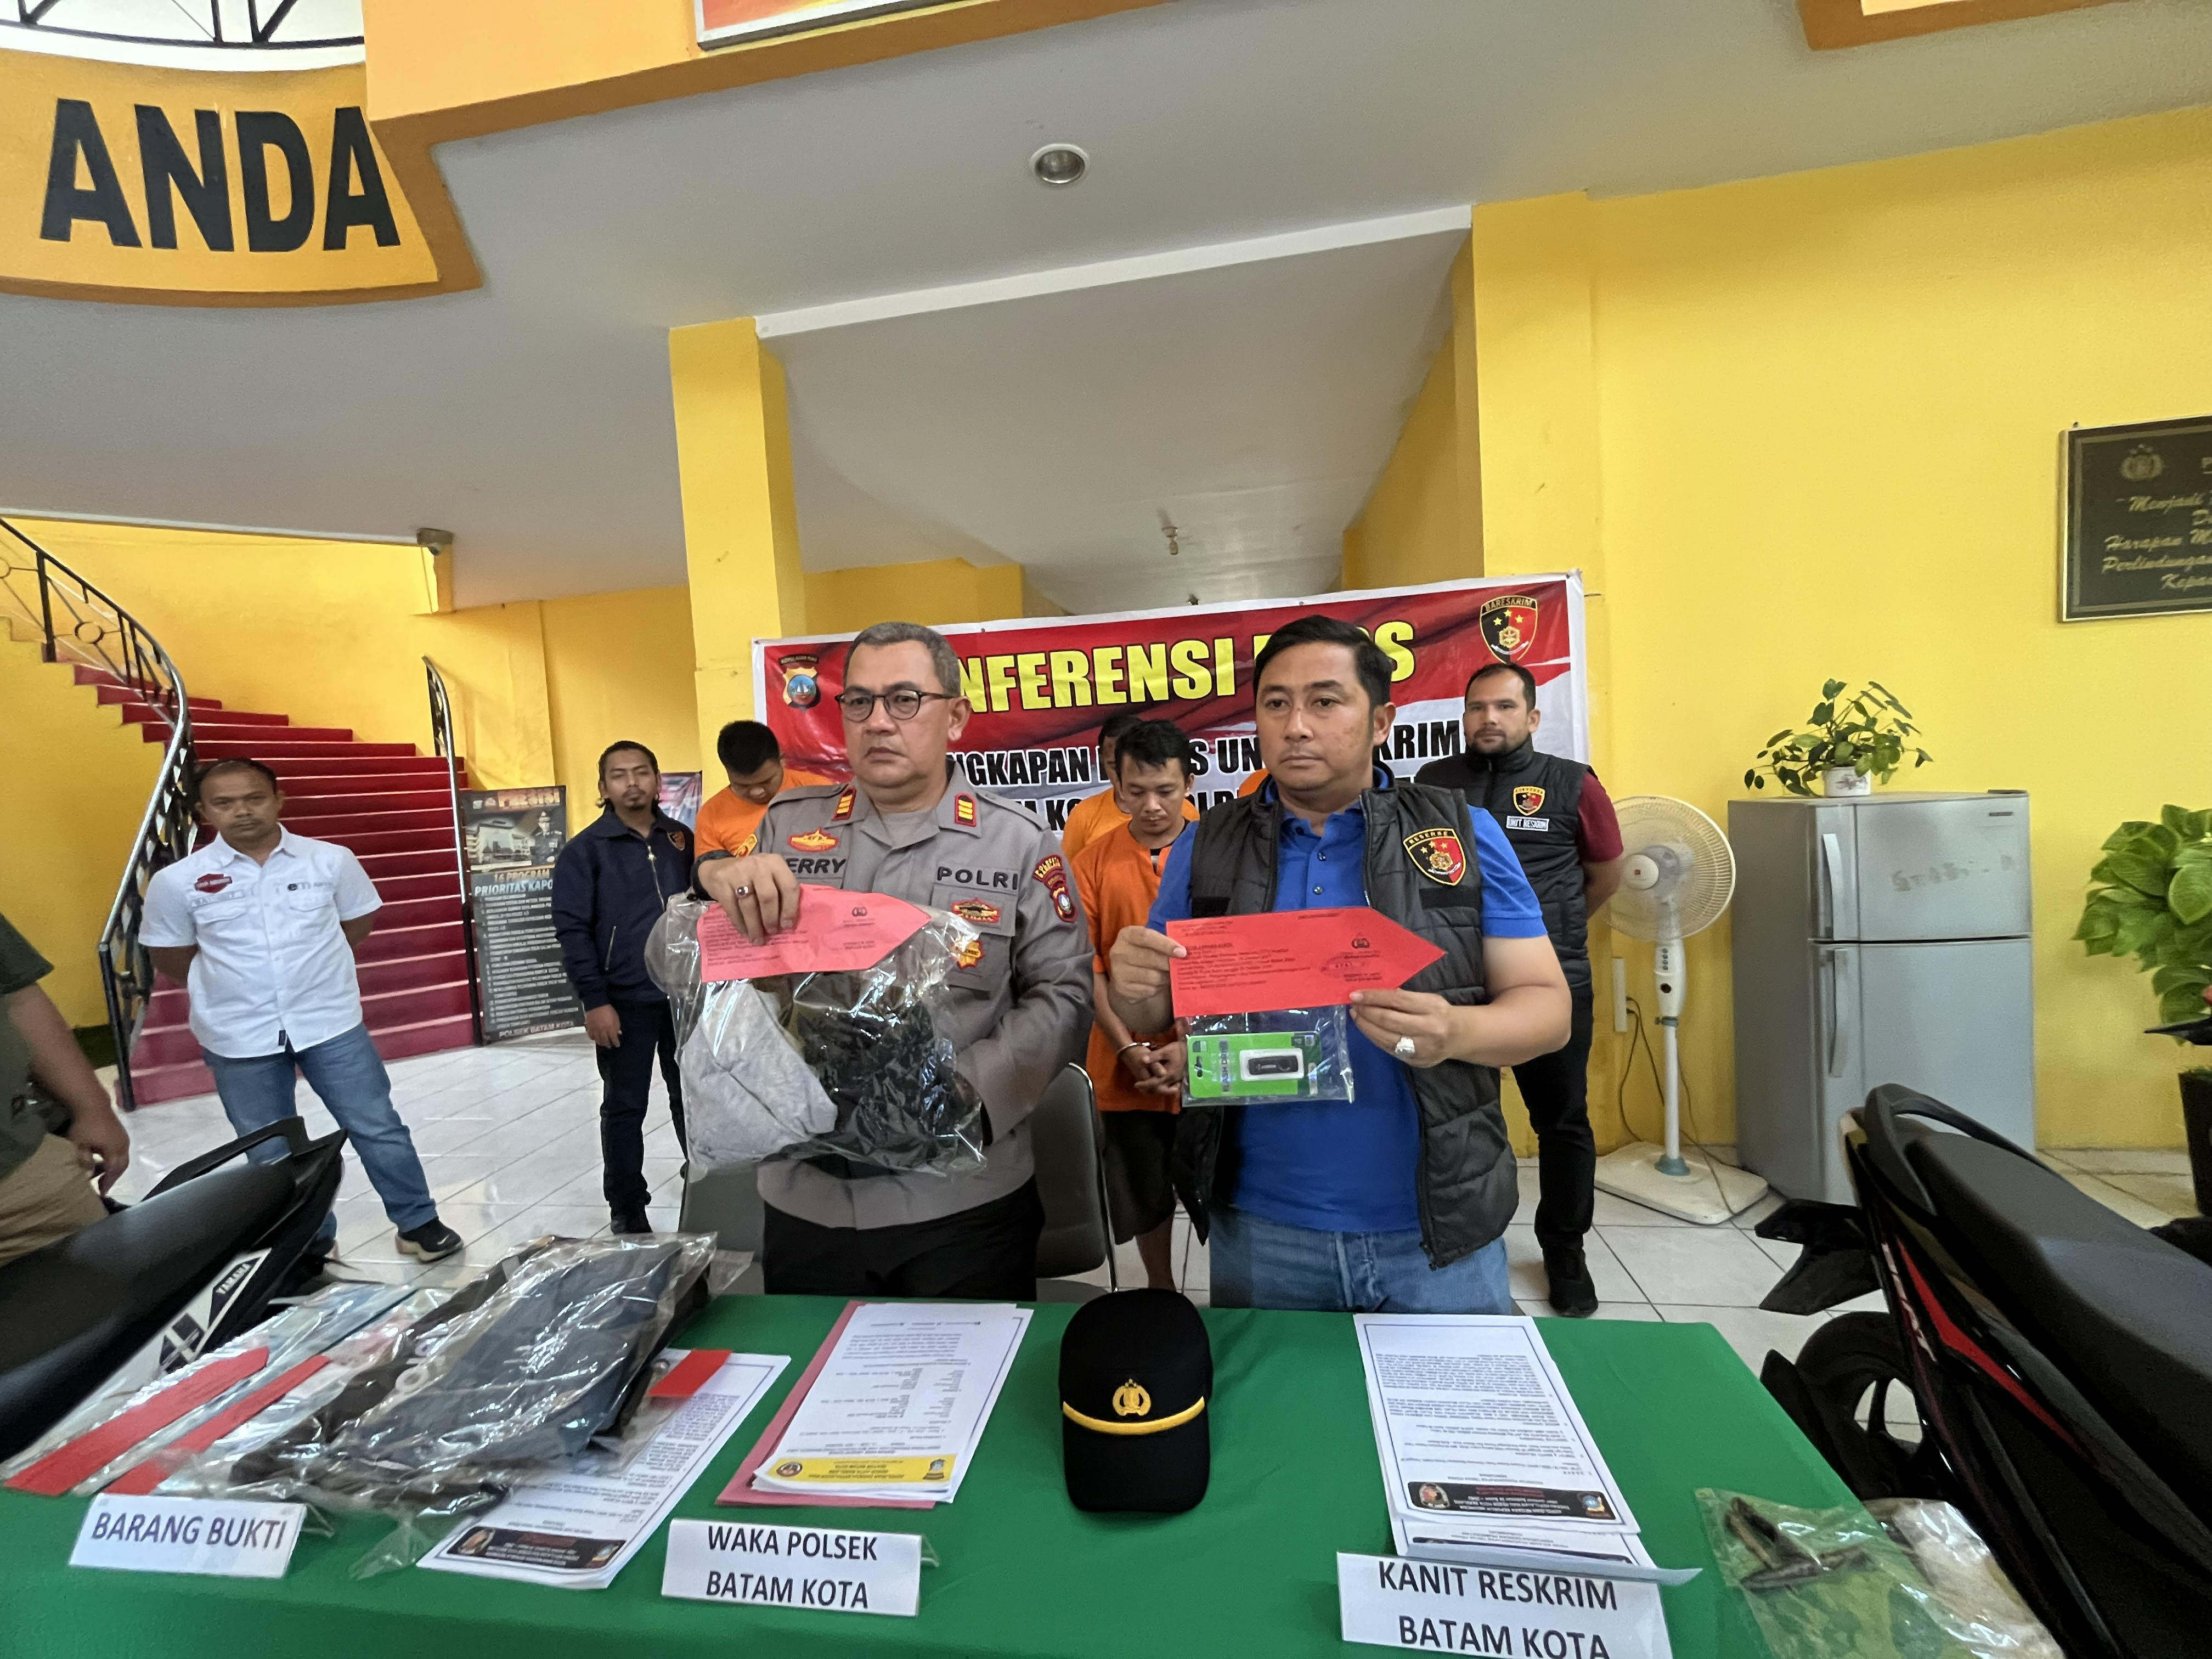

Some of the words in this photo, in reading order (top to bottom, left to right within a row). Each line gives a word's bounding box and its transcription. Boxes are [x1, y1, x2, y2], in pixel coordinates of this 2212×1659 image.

[40, 98, 401, 252] ANDA
[960, 637, 1237, 713] NFERENSI
[946, 748, 1089, 785] GKAPAN
[1217, 738, 1262, 774] UN
[506, 868, 550, 882] PROGRAM
[785, 857, 846, 874] ERRY
[937, 866, 1018, 890] POLRI
[474, 880, 527, 896] PRIORITAS
[528, 879, 554, 891] KAPO
[91, 1512, 203, 1545] BARANG
[206, 1517, 287, 1549] BUKTI
[708, 1525, 779, 1556] WAKA
[787, 1531, 877, 1561] POLSEK
[706, 1571, 793, 1604] BATAM
[802, 1578, 868, 1609] KOTA
[1379, 1561, 1468, 1597] KANIT
[1479, 1571, 1617, 1610] RESKRIM
[1399, 1615, 1512, 1655] BATAM
[1522, 1628, 1610, 1659] KOTA
